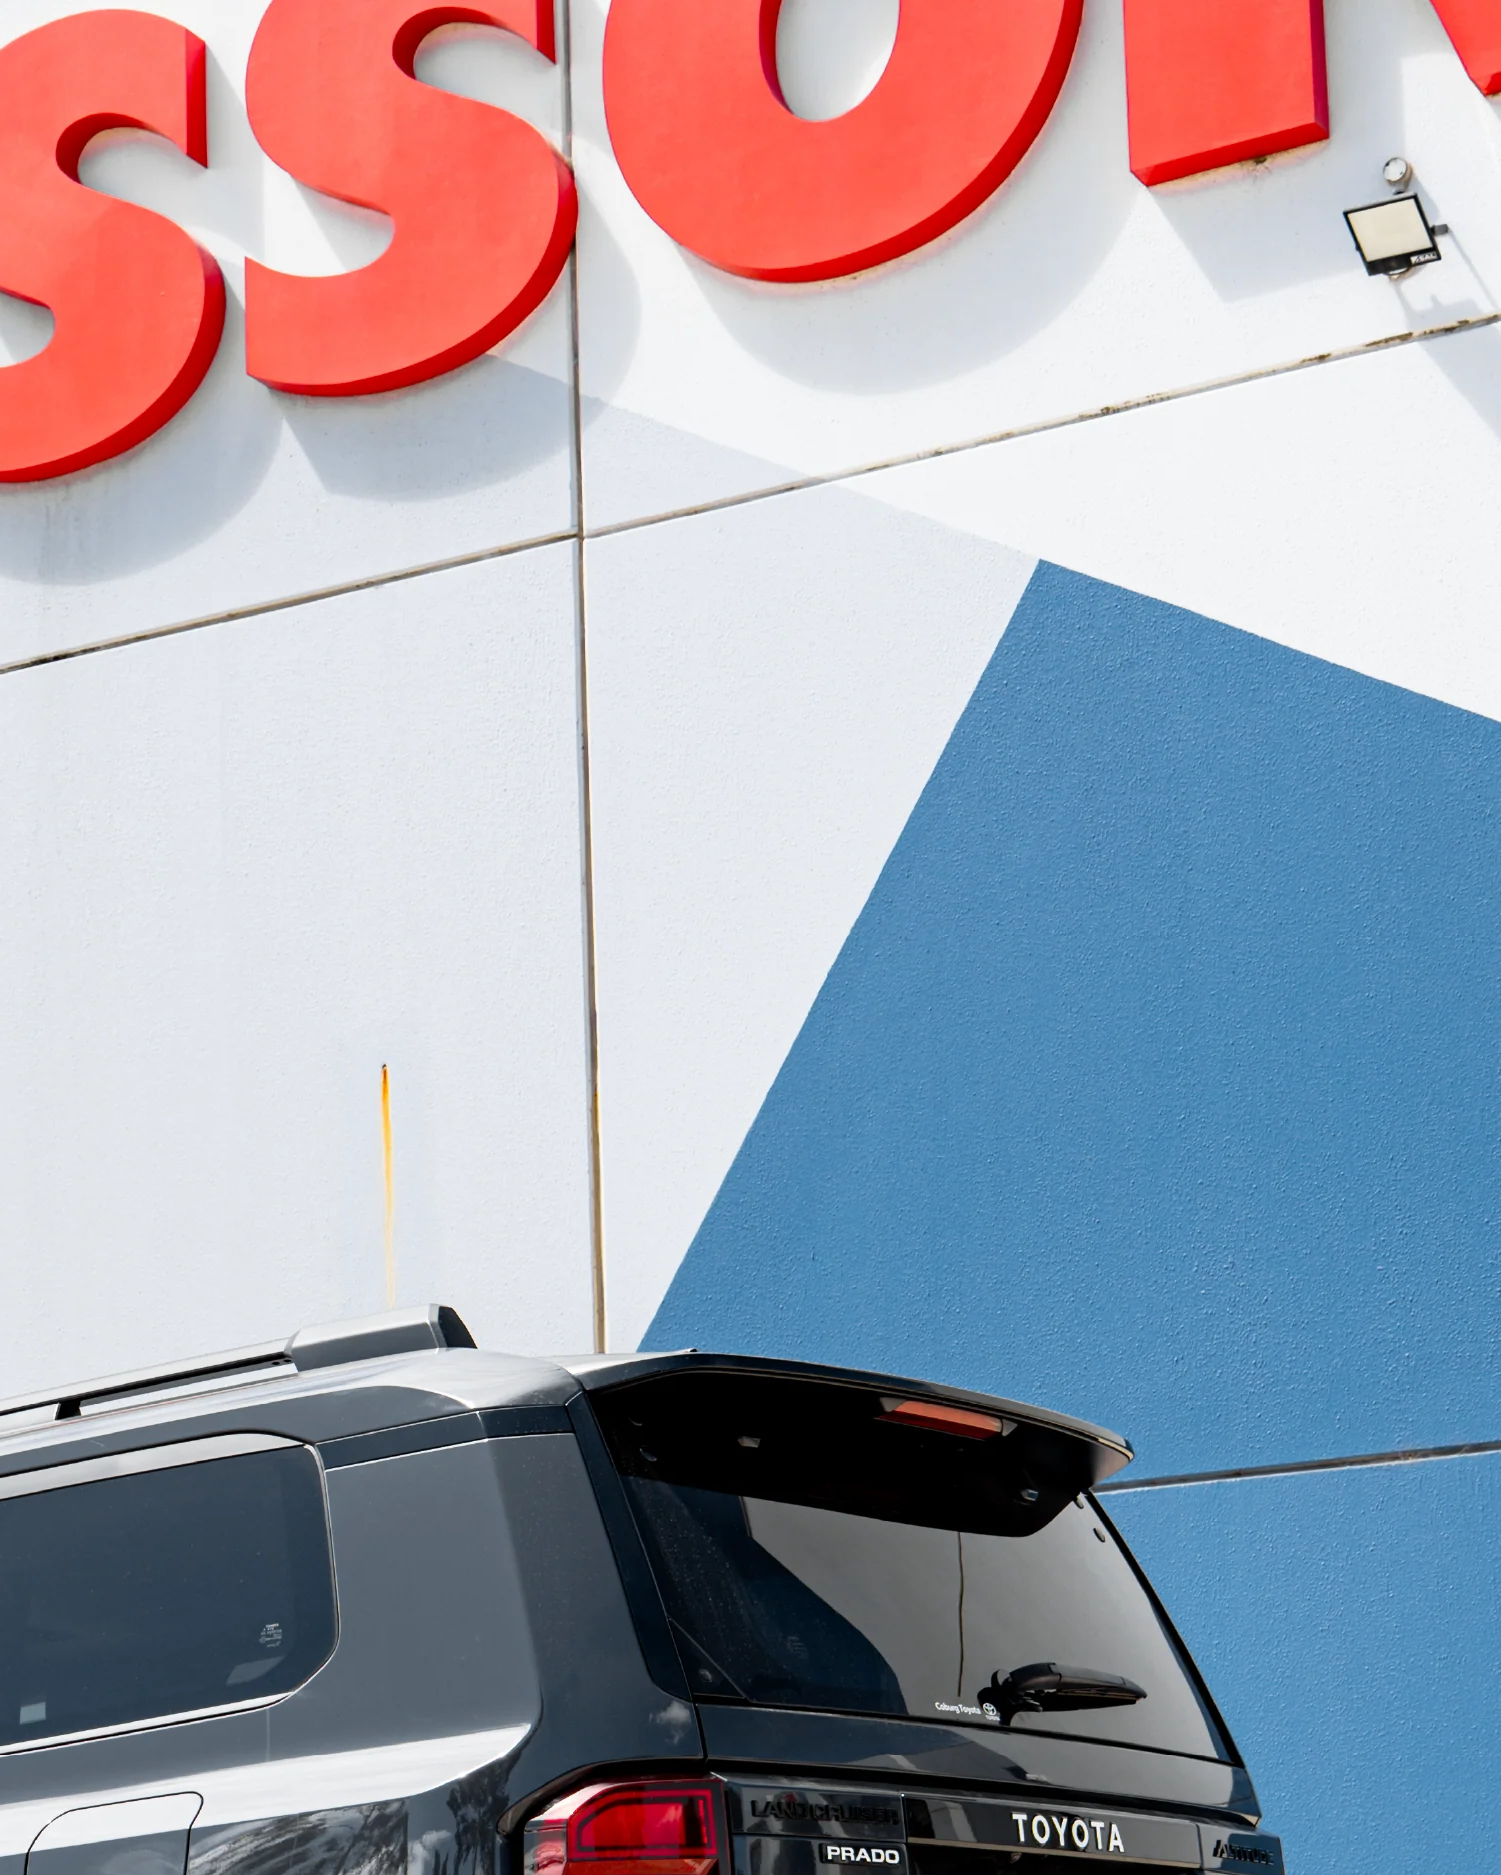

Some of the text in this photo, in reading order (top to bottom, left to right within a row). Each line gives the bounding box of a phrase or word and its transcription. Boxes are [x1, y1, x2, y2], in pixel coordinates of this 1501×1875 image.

[934, 1701, 981, 1715] Coburg Toyota
[1011, 1812, 1125, 1853] TOYOTA
[826, 1844, 900, 1864] PRADO
[1213, 1839, 1274, 1866] ALTITUDE
